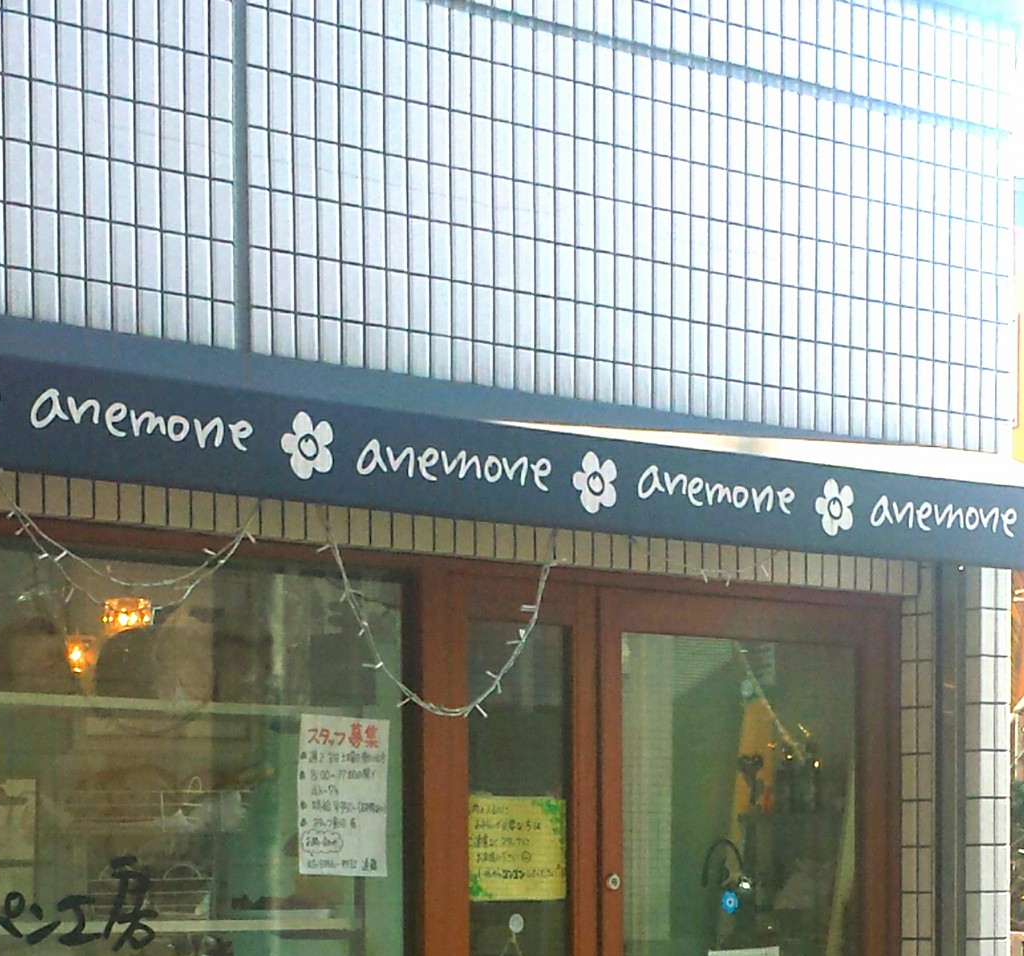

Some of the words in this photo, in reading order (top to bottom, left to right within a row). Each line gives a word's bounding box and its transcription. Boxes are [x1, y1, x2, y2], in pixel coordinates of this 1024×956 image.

[30, 387, 254, 452] anemone
[356, 437, 553, 493] anemone
[637, 463, 796, 516] anemone
[870, 495, 1019, 538] anemone
